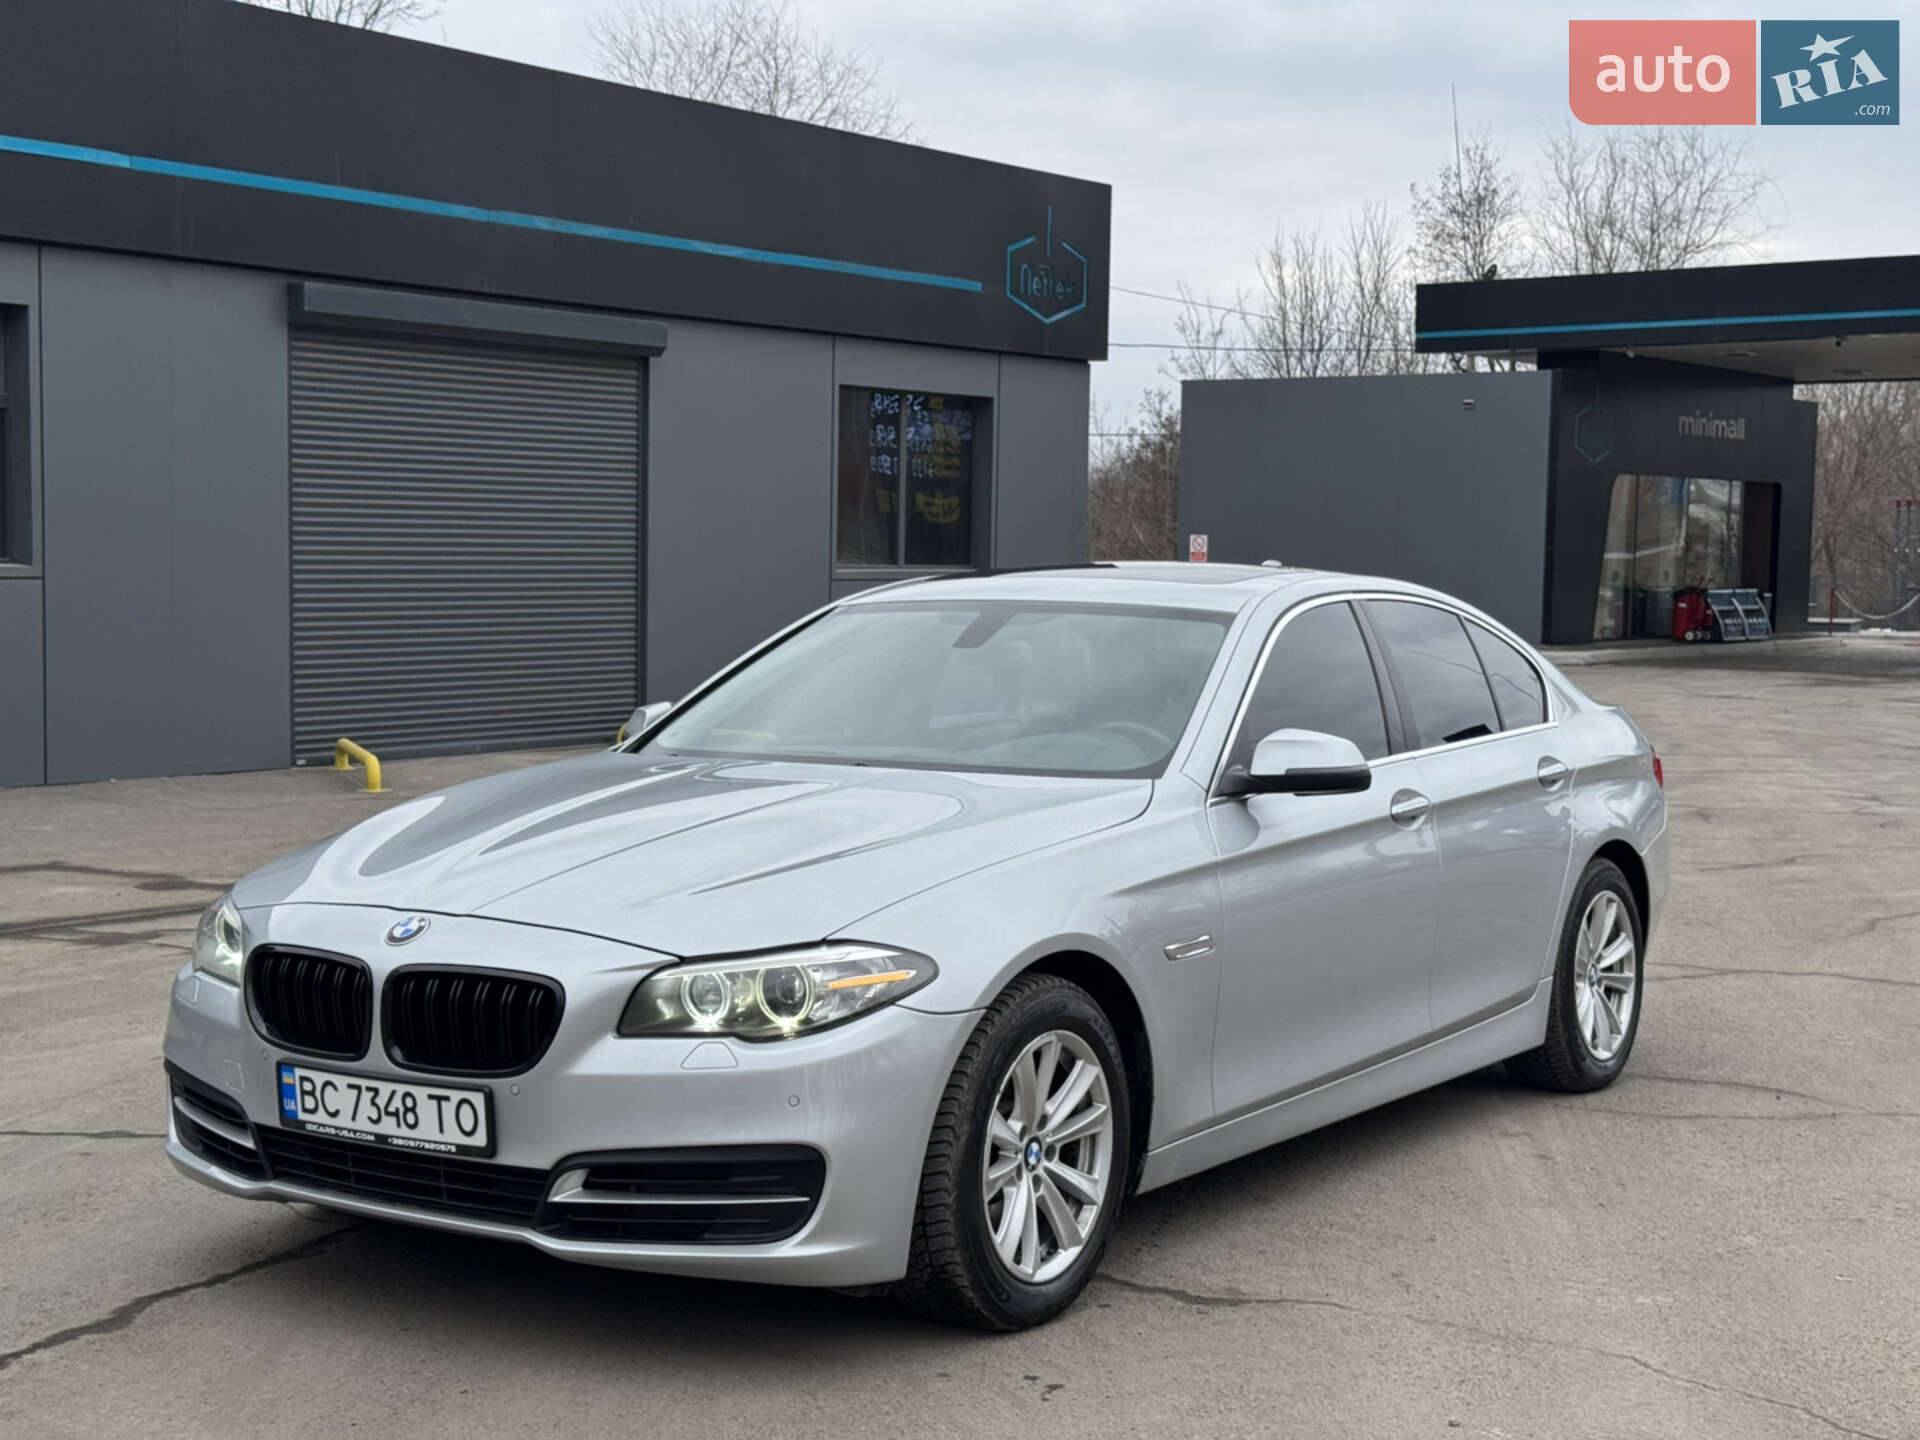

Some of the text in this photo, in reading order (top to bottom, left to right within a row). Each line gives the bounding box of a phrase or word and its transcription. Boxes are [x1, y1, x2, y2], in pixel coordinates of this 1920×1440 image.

[1678, 410, 1745, 440] minimall
[299, 1075, 479, 1138] BC 7348 TO
